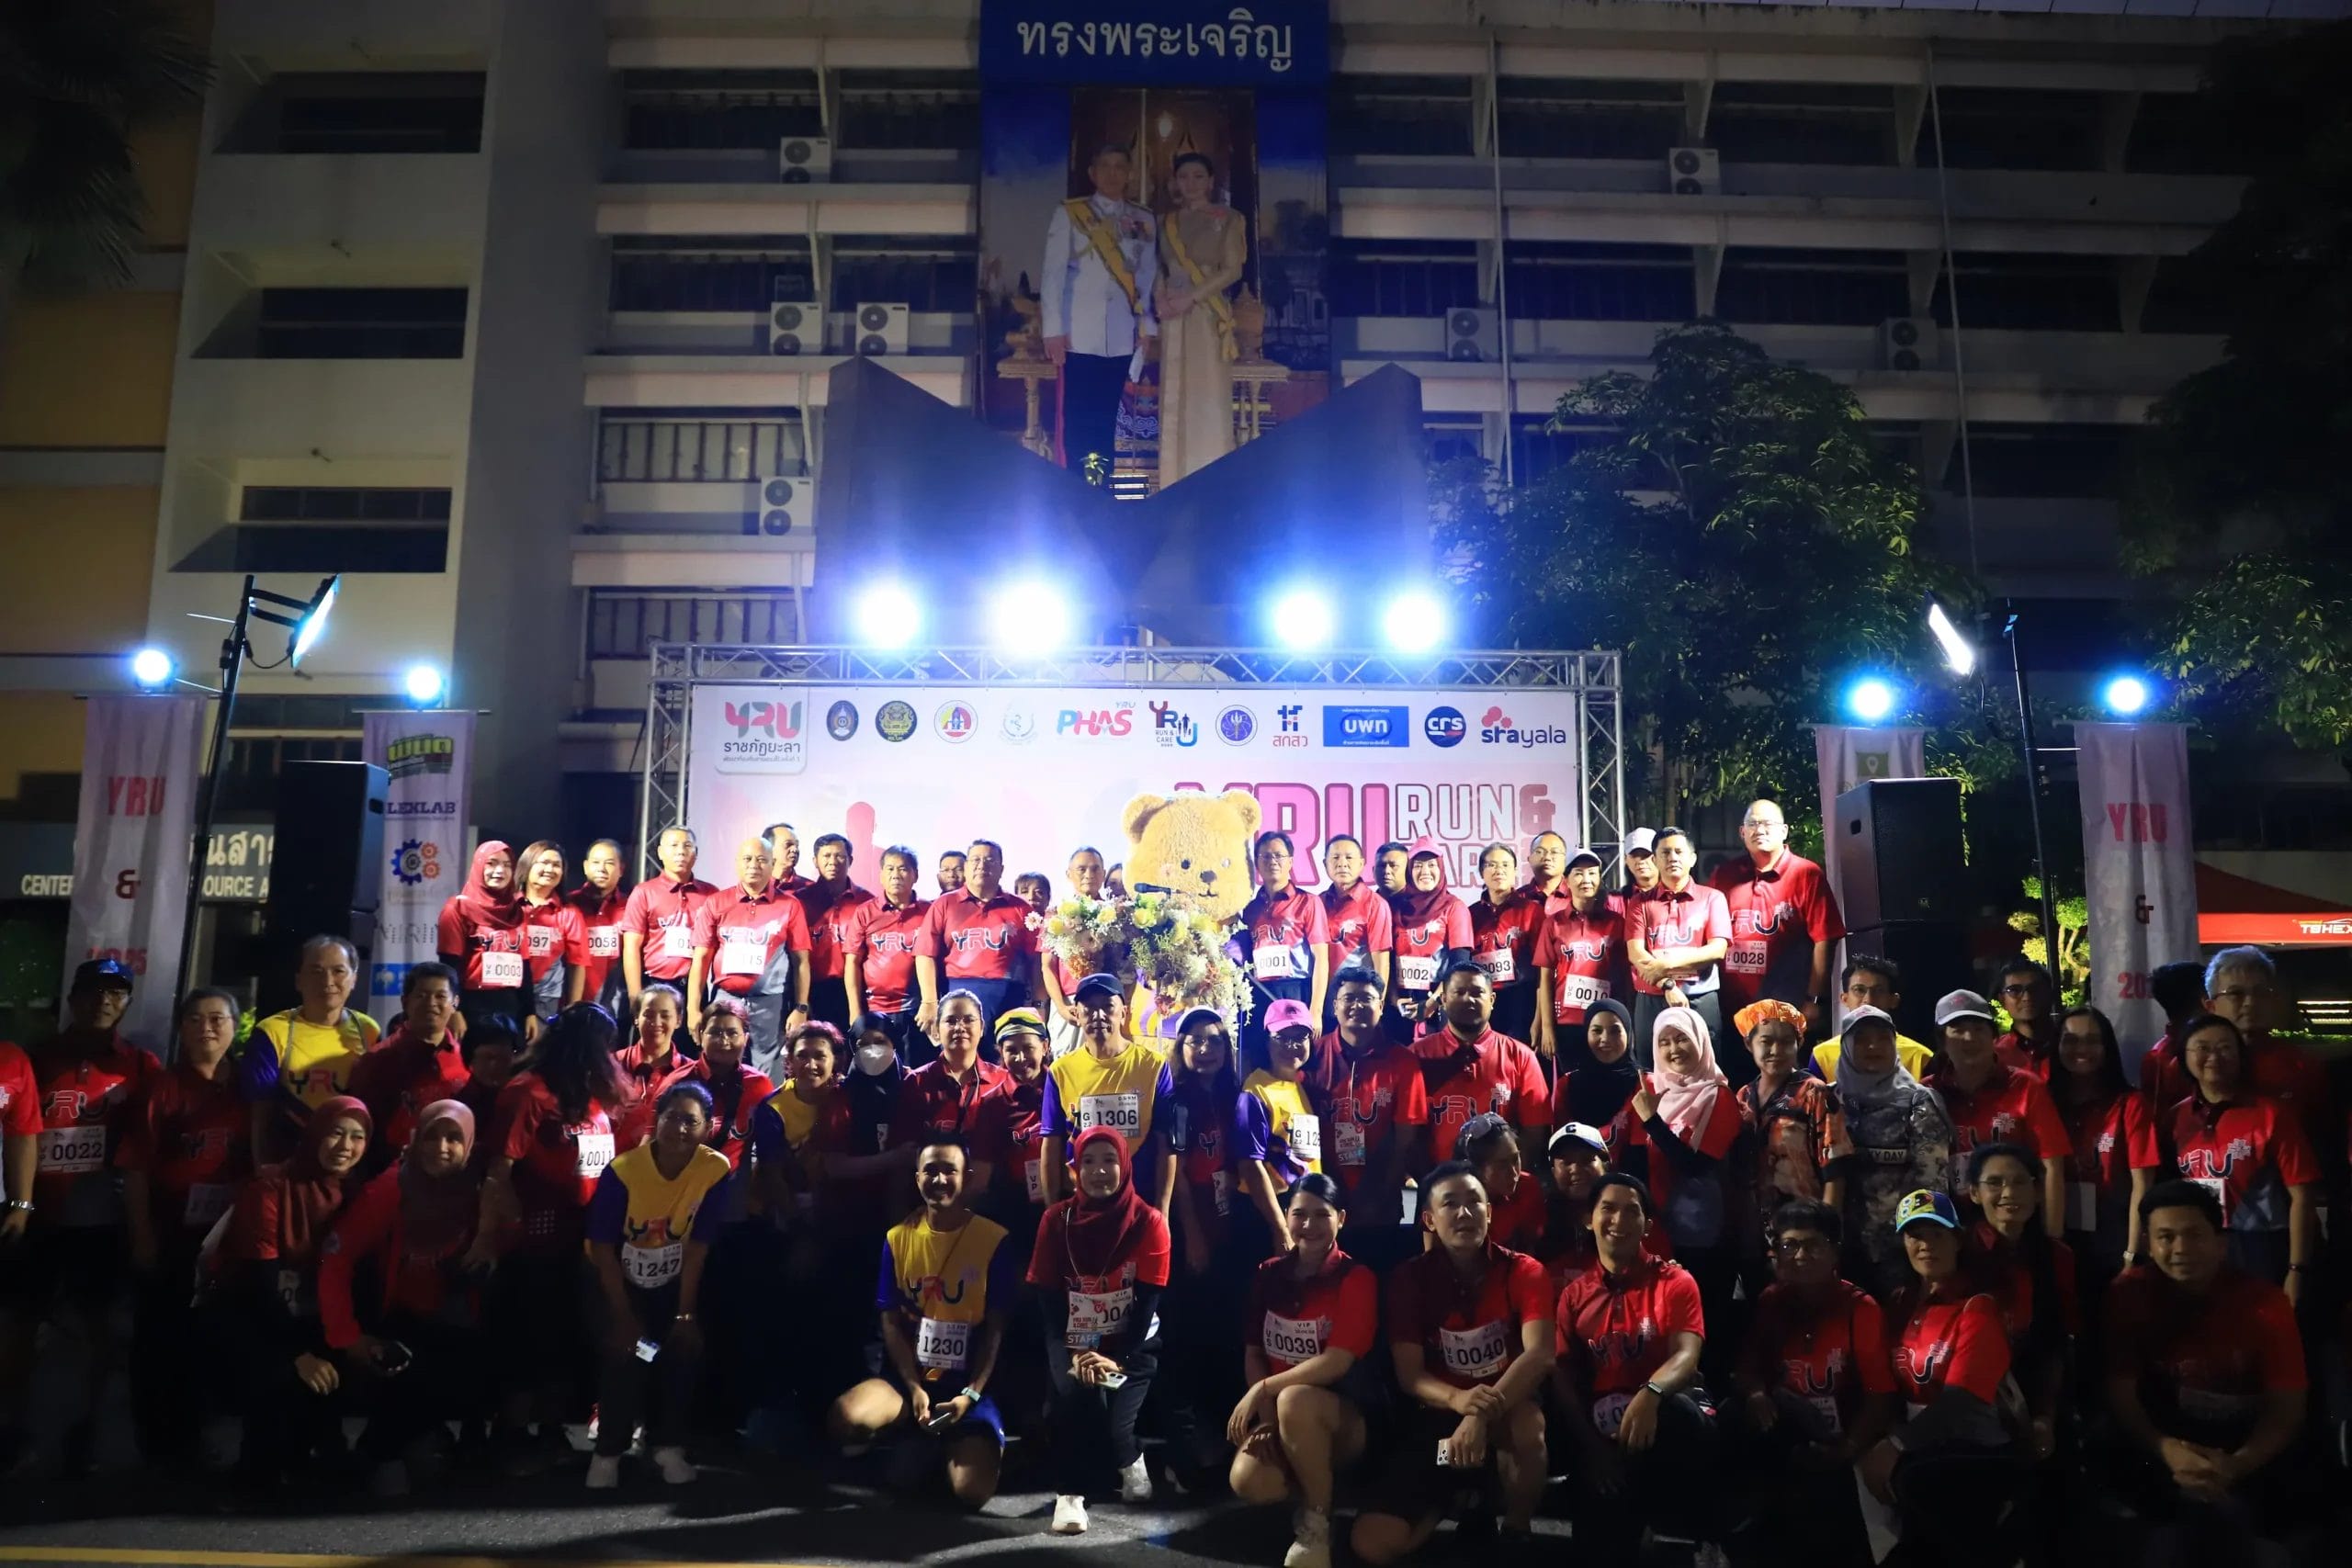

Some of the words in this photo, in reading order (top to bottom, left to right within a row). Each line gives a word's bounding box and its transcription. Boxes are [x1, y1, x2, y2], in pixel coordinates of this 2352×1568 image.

[1017, 7, 1292, 72] ทรงพระเจริญ
[724, 739, 801, 756] ราชภัฏยะลา
[107, 776, 166, 817] YRU
[2108, 803, 2167, 842] YRU
[952, 927, 1007, 952] YRU
[1733, 951, 1765, 964] 0028
[1401, 967, 1430, 981] 0002
[1096, 1109, 1137, 1126] 1306
[51, 1142, 103, 1161] 0022
[637, 1258, 680, 1277] 1247
[922, 1336, 965, 1357] 1230
[1274, 1333, 1317, 1355] 0039
[1457, 1337, 1504, 1366] 0040
